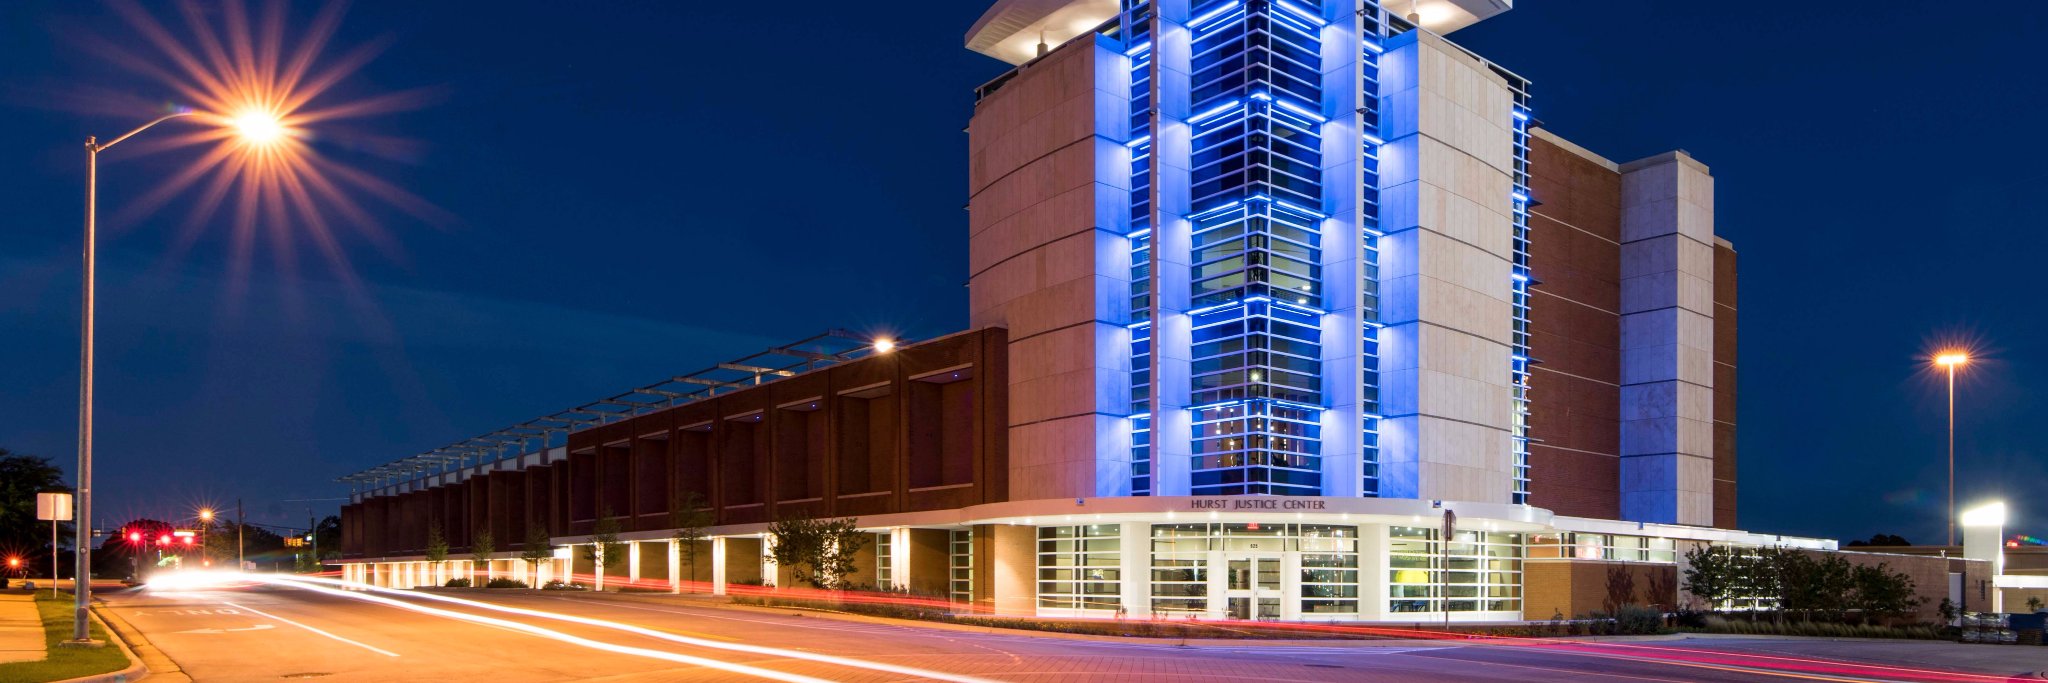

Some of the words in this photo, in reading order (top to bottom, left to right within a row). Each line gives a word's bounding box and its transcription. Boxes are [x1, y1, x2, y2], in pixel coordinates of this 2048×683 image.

[1191, 499, 1227, 509] HURST
[1234, 499, 1277, 509] JUSTICE
[1283, 499, 1325, 509] CENTER
